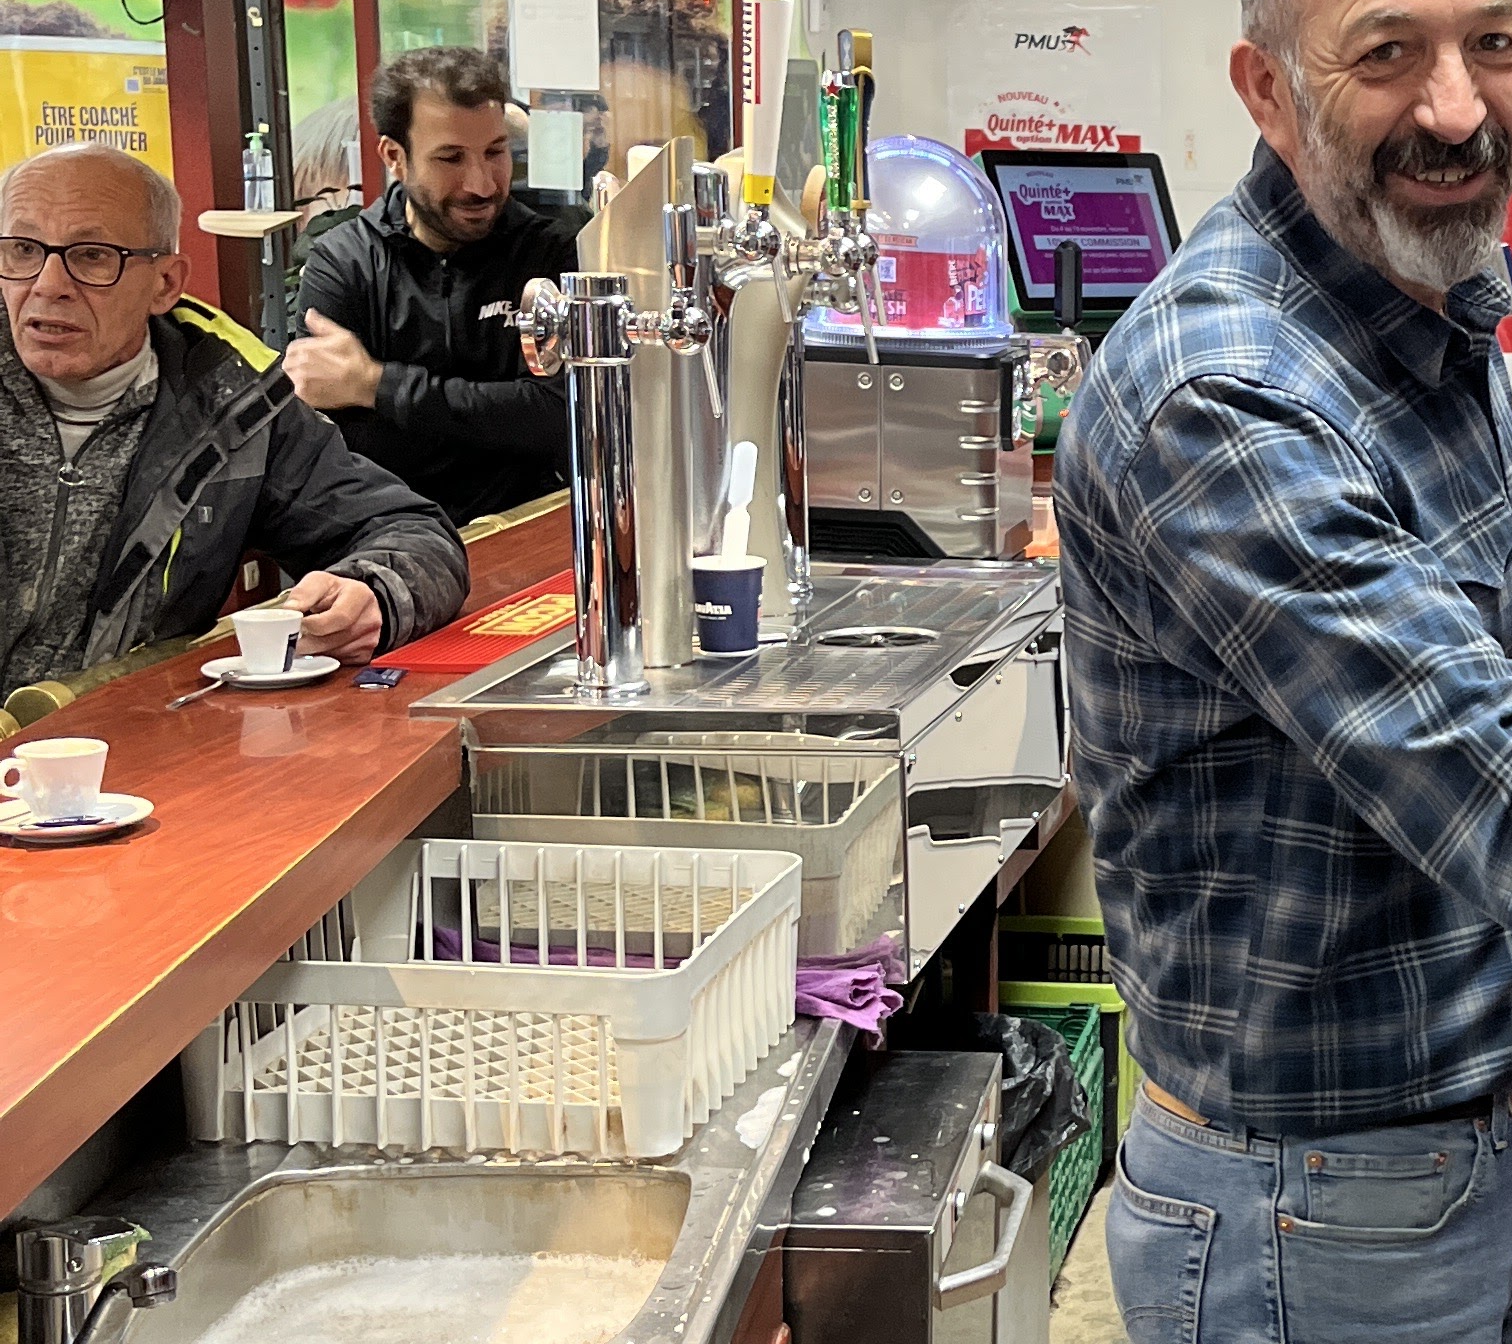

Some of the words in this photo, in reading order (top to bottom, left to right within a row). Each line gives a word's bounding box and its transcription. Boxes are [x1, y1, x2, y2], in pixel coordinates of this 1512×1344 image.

[1014, 33, 1060, 50] PMU
[997, 91, 1049, 105] NOUVEAU
[42, 101, 76, 126] ÊTRE
[79, 102, 139, 127] COACHÉ
[36, 126, 75, 145] POUR
[988, 113, 1056, 134] Quinté+
[1055, 124, 1117, 151] MAX
[1019, 183, 1071, 200] Quinté+
[1044, 205, 1073, 218] MAX
[1080, 237, 1141, 247] COMMISSION
[478, 300, 512, 320] NIKE
